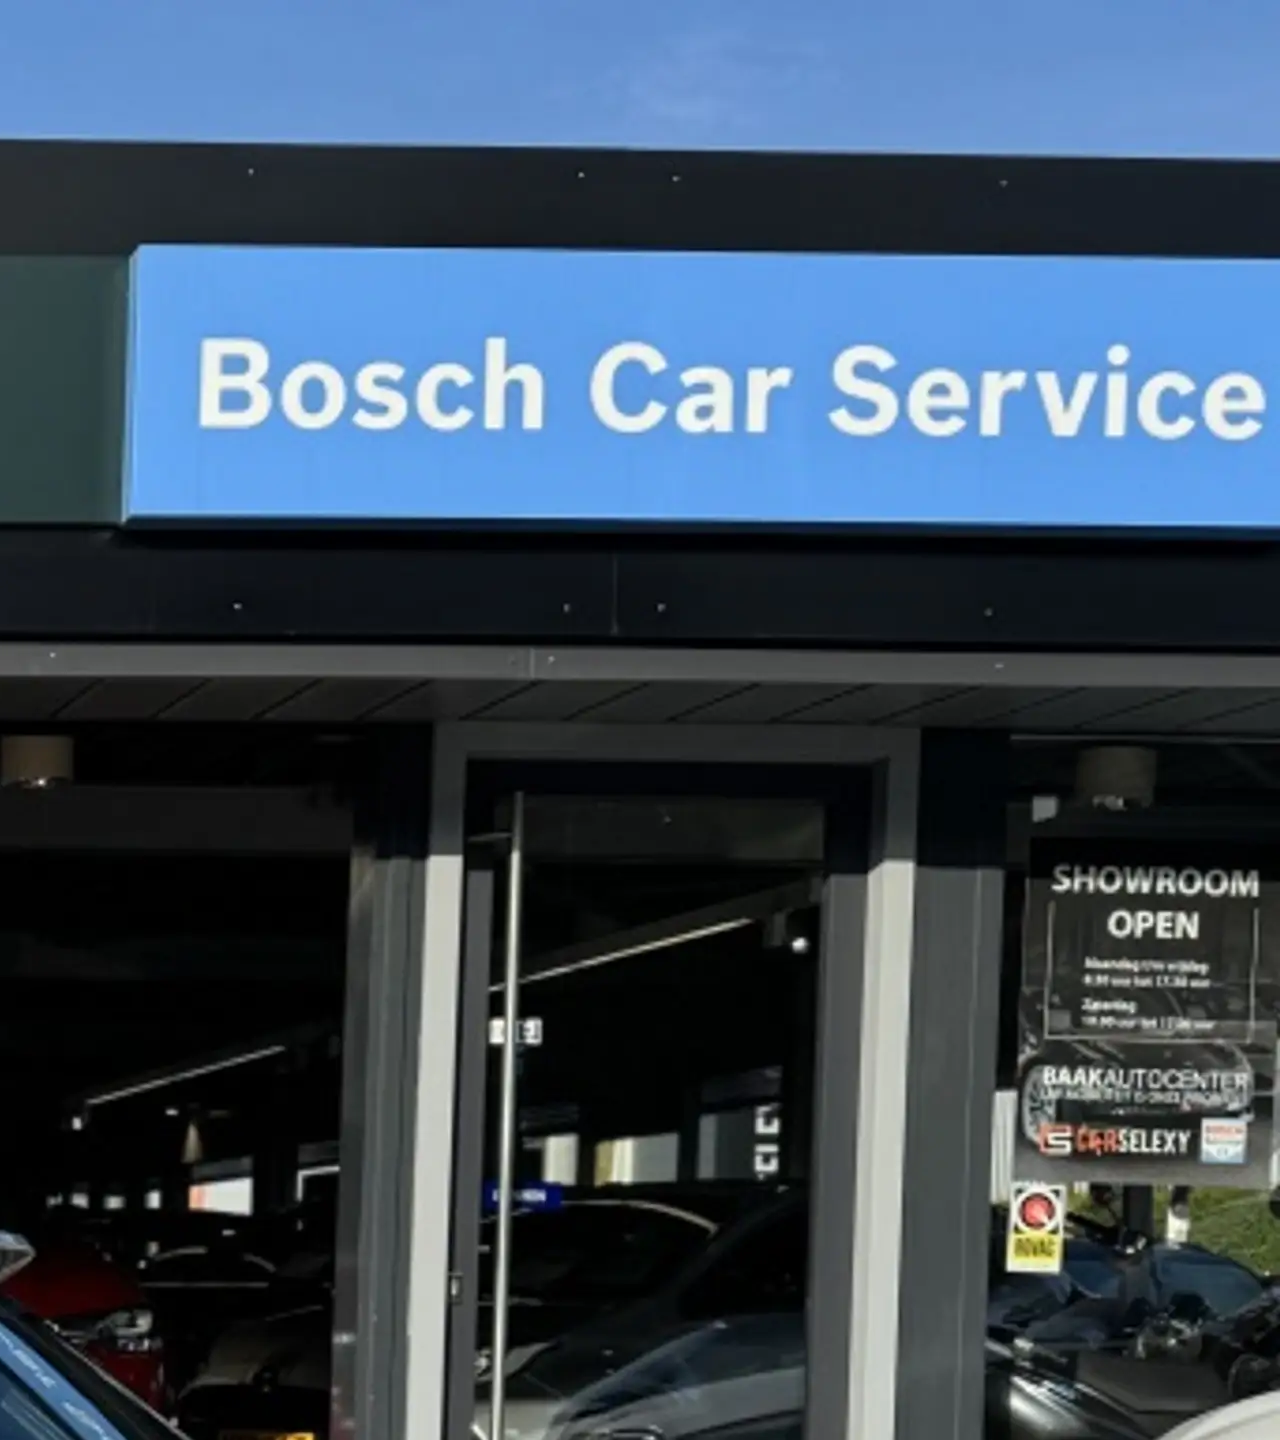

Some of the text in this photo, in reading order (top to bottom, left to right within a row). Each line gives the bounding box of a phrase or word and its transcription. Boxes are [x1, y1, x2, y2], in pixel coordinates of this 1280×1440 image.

[197, 335, 1267, 441] Bosch Car Service
[1051, 863, 1260, 898] SHOWROOM
[1106, 908, 1200, 939] OPEN
[1042, 1064, 1249, 1093] BAAKAUTOCENTER
